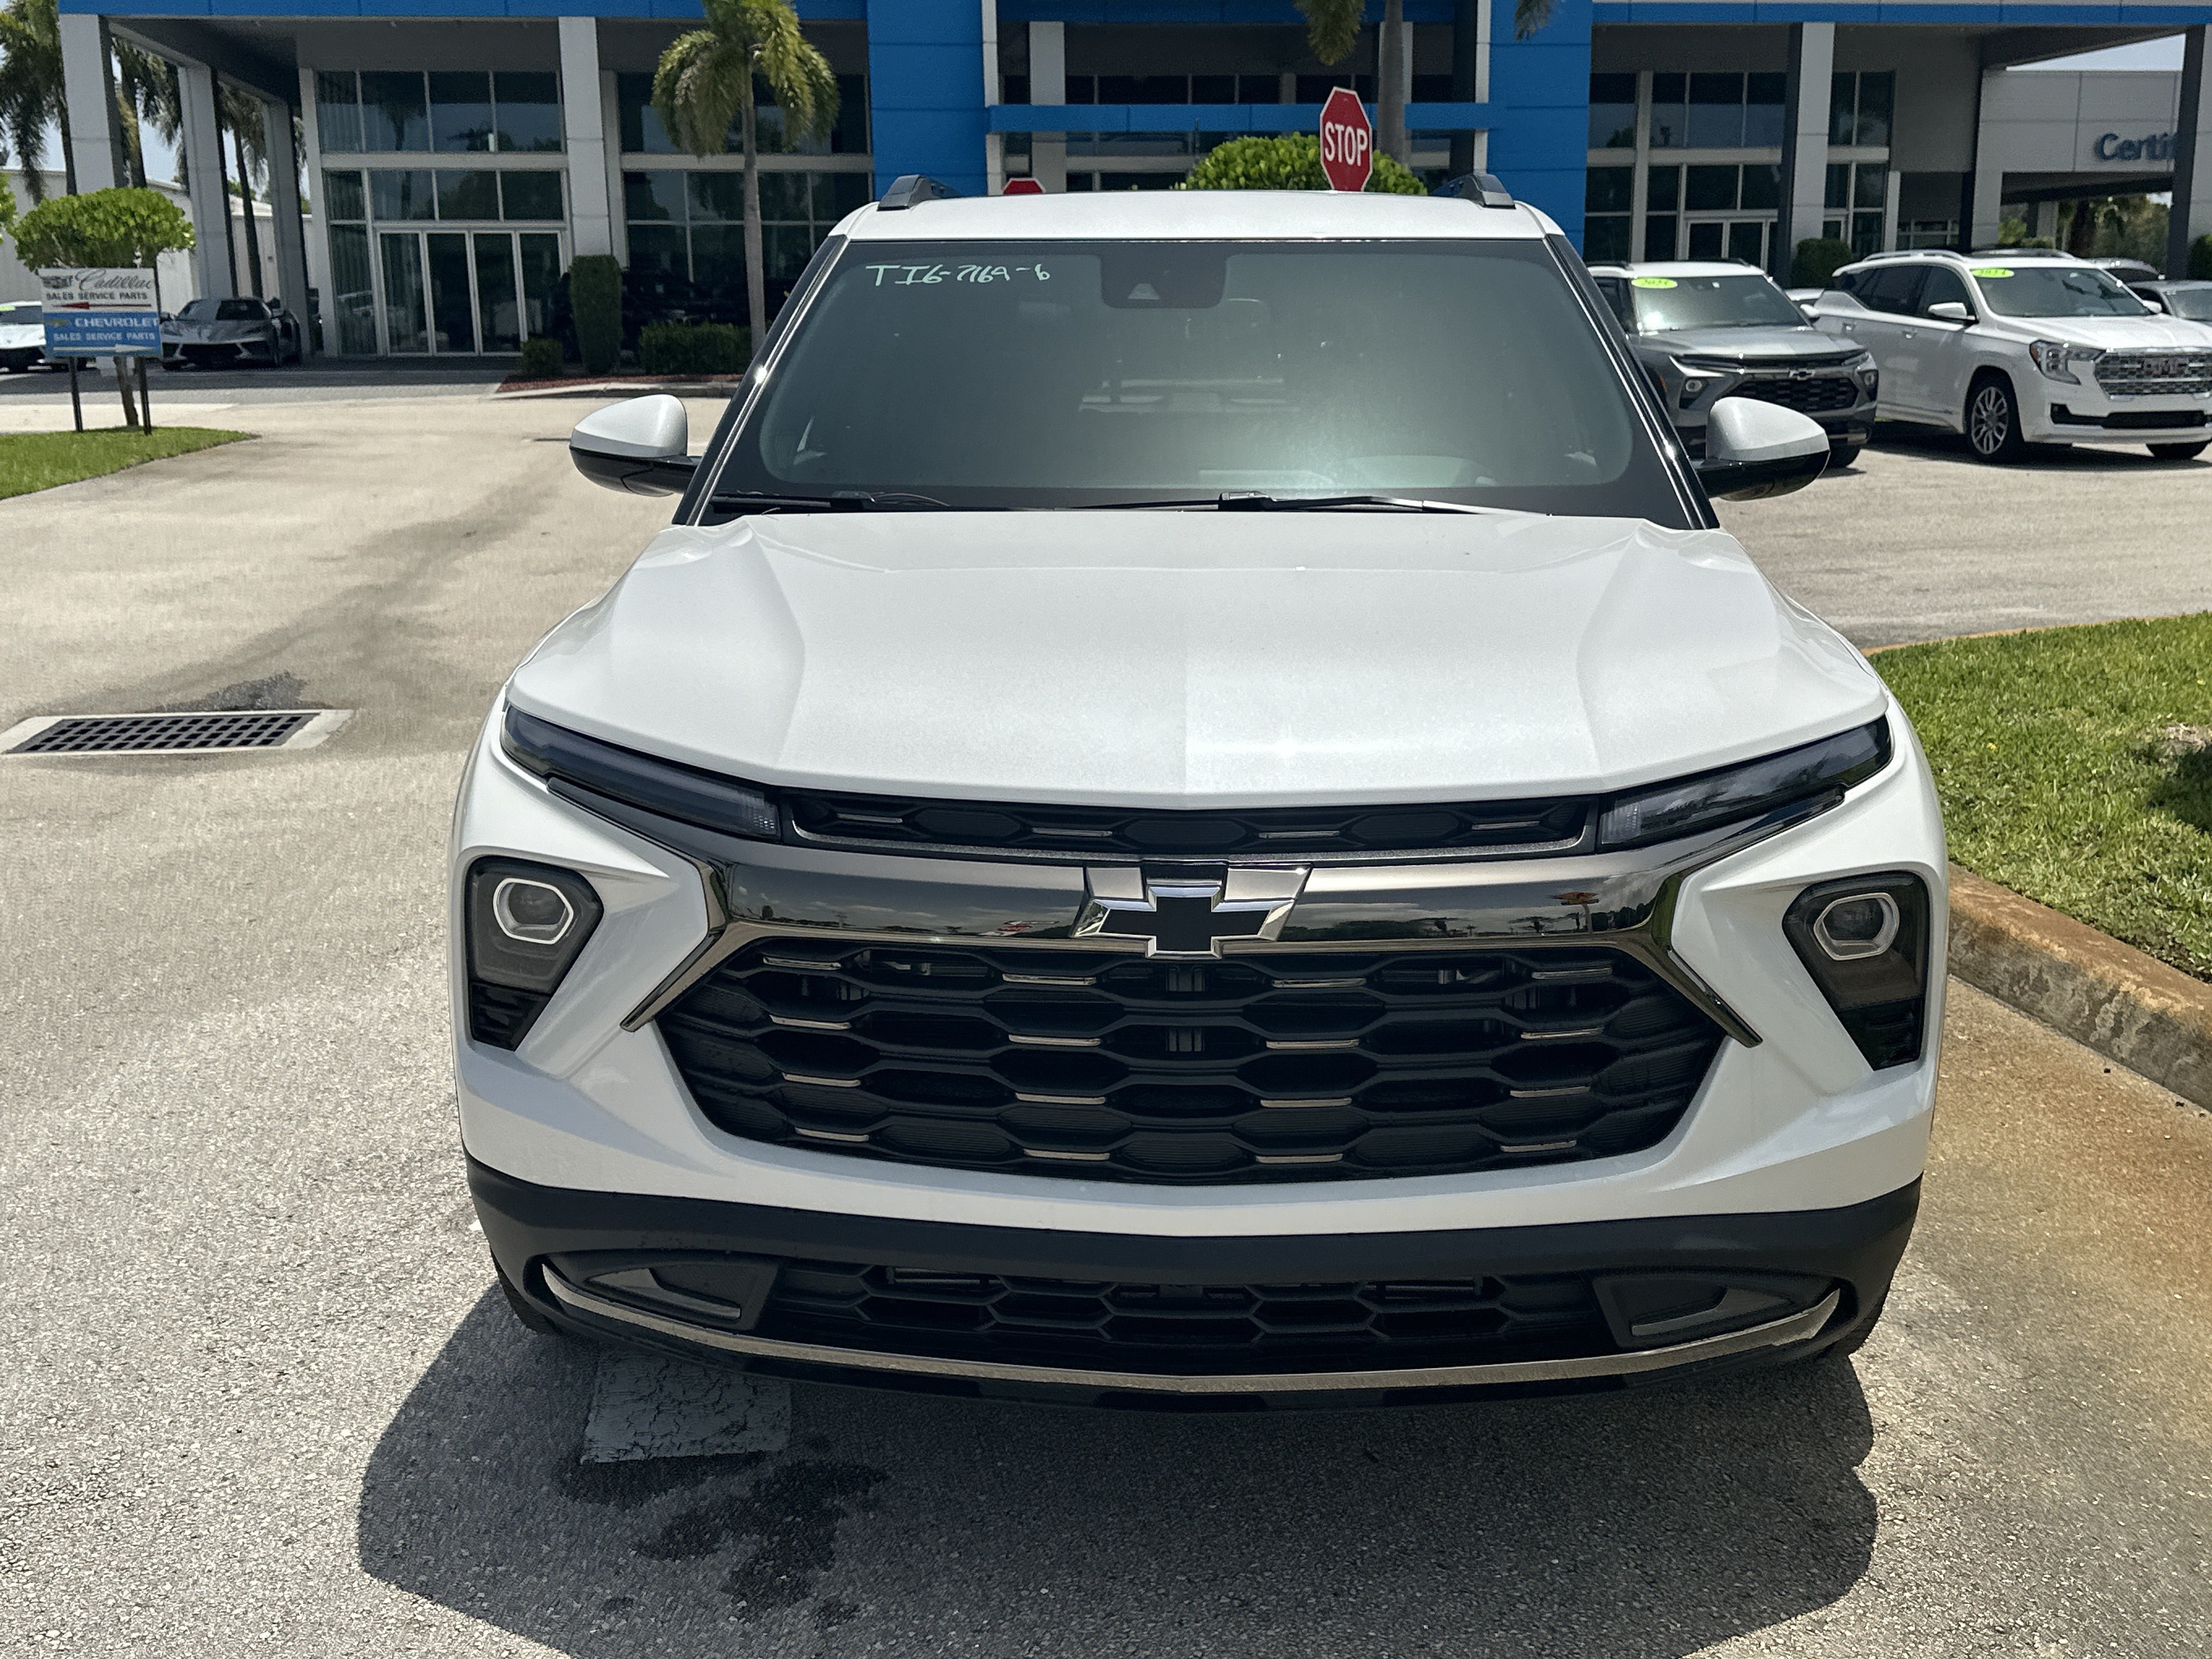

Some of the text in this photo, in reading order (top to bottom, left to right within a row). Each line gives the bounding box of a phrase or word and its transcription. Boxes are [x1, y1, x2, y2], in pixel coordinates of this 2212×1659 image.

[1324, 121, 1368, 167] STOP
[75, 268, 152, 290] Cadillac
[46, 291, 148, 301] SALES SERVICE PARTS
[75, 318, 159, 328] CHEVROLET
[53, 331, 156, 341] SALES SERVICE PARTS
